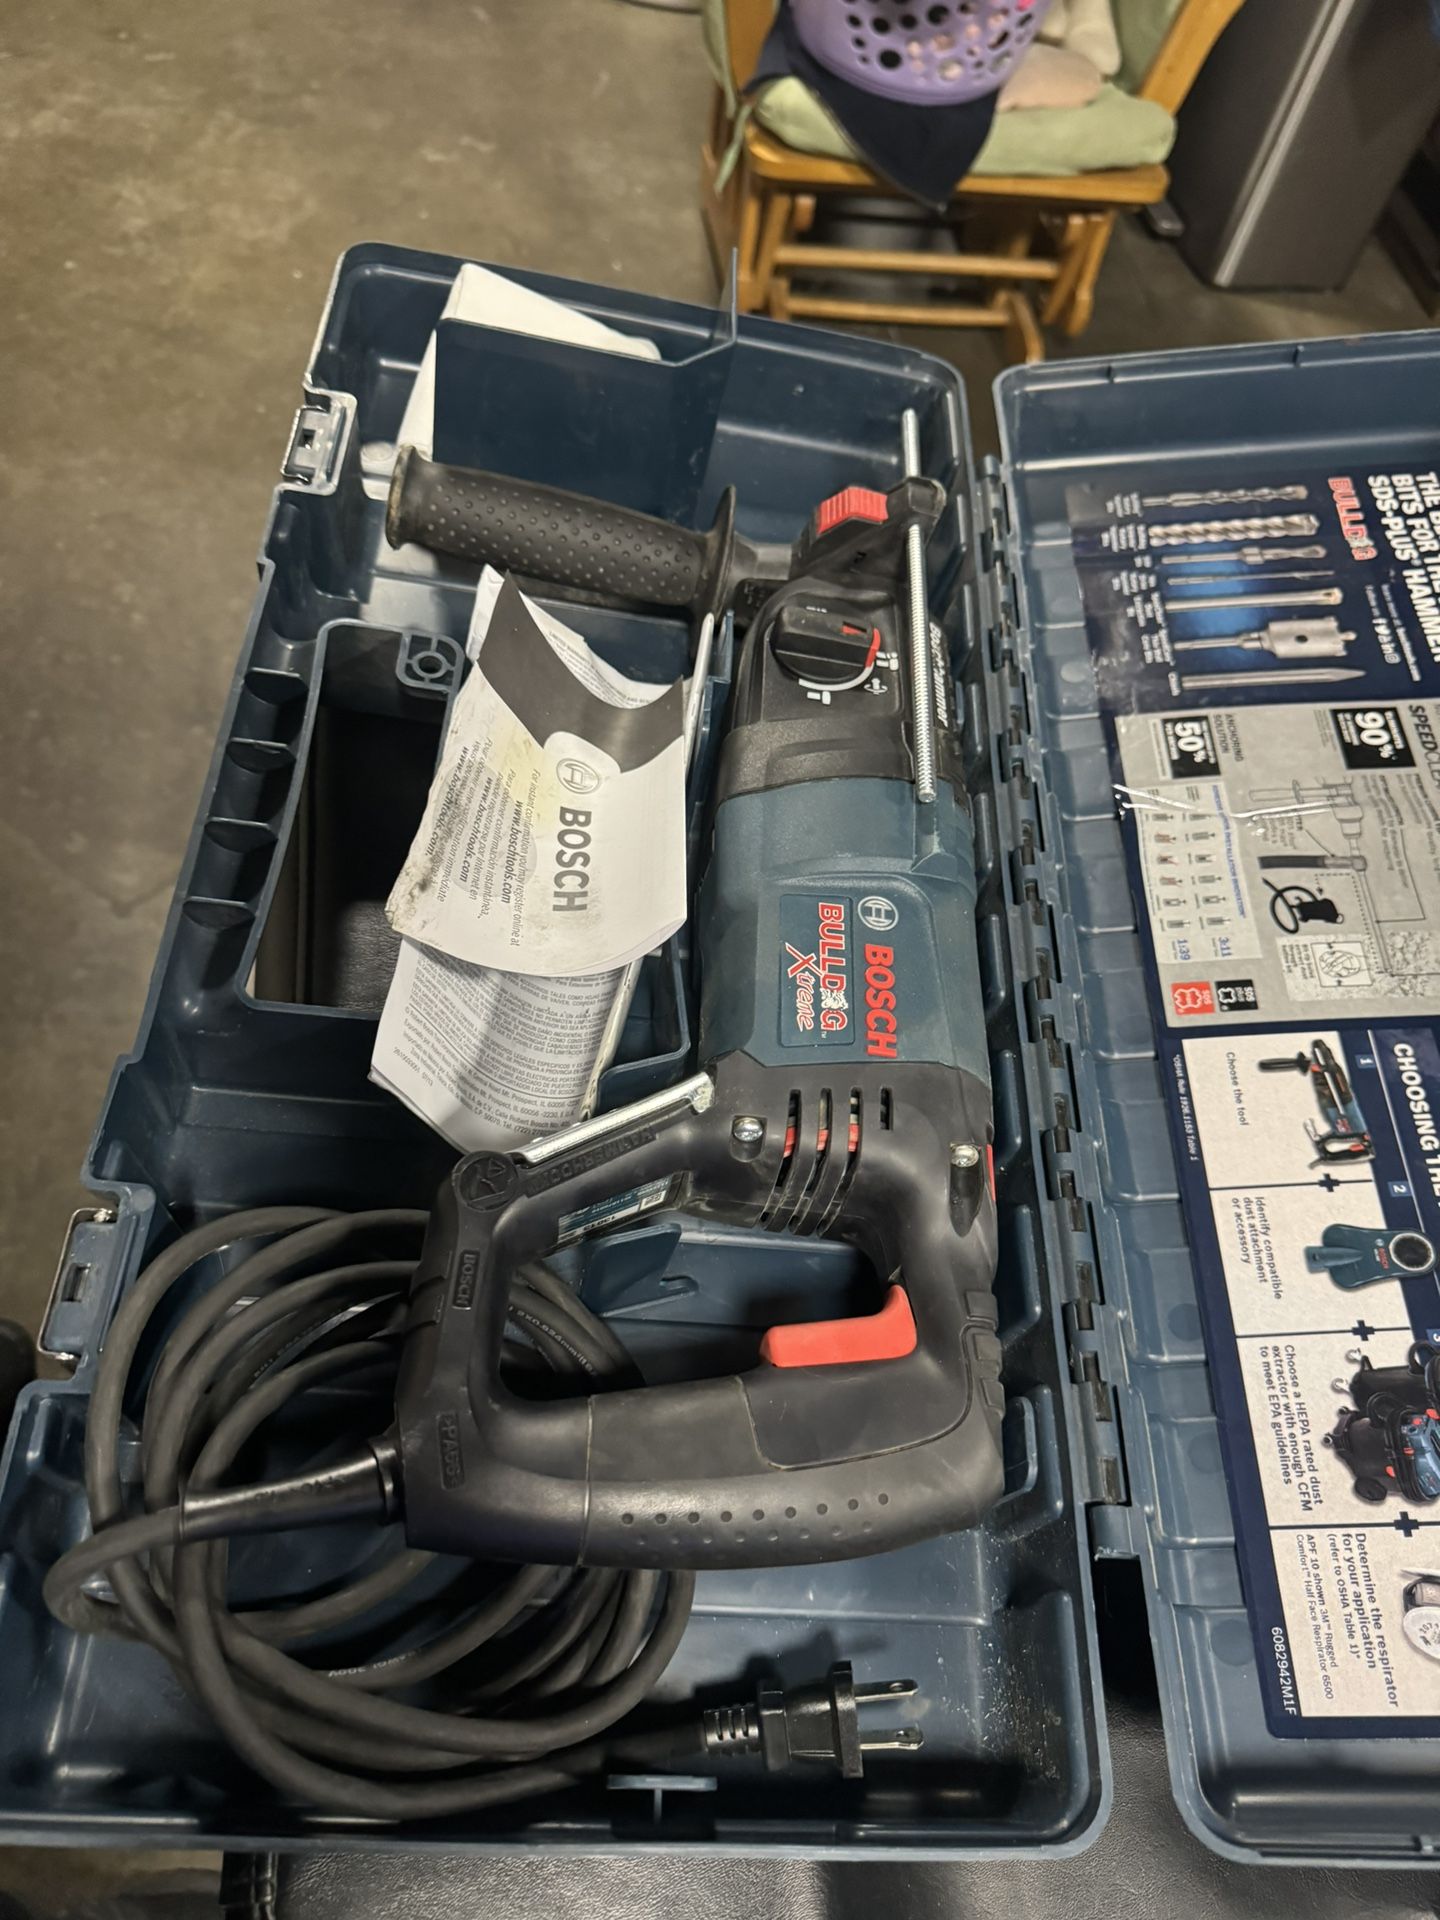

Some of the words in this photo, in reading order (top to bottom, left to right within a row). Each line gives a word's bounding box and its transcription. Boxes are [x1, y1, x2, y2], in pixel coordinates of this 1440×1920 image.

[1391, 474, 1424, 515] BITS
[1406, 517, 1439, 553] FOR
[481, 737, 494, 757] Pour
[1174, 722, 1206, 763] 50%
[1214, 714, 1230, 753] SOLUTION
[1225, 714, 1243, 762] ANCHORING
[472, 757, 486, 788] obtenir
[492, 772, 504, 799] puede
[505, 768, 517, 788] Para
[530, 768, 541, 783] For
[466, 786, 477, 803] une
[497, 787, 512, 820] obtener
[526, 783, 540, 809] instant
[460, 777, 494, 883] www.boschtools.com
[481, 798, 498, 842] registrarse
[520, 808, 534, 855] confirmation
[477, 841, 488, 858] por
[487, 819, 505, 870] confirmación
[501, 800, 524, 904] www.boschtools.com
[552, 806, 592, 912] BOSCH
[437, 856, 456, 902] immédiate
[470, 857, 485, 889] Internet
[468, 889, 478, 900] en
[513, 885, 526, 912] register
[510, 914, 523, 938] online
[510, 938, 520, 946] at
[1177, 939, 1191, 960] 1:39
[1219, 937, 1233, 957] 3:11
[784, 942, 823, 1032] Xtreme
[864, 943, 897, 1059] BOSCH
[1226, 1052, 1239, 1086] Choose
[1359, 1057, 1372, 1066] 1
[1233, 1089, 1244, 1104] the
[1394, 1043, 1438, 1151] CHOOSING
[1237, 1107, 1249, 1126] tool
[1231, 1198, 1240, 1208] or
[1393, 1184, 1406, 1194] 2
[1243, 1197, 1254, 1220] dust
[1234, 1212, 1251, 1264] accessory
[1248, 1223, 1268, 1283] attachment
[1255, 1196, 1271, 1236] Identify
[1264, 1239, 1283, 1300] compatible
[456, 1252, 478, 1307] BOSCH
[1259, 1346, 1269, 1358] to
[1284, 1345, 1300, 1387] Choose
[1262, 1361, 1276, 1391] meet
[1272, 1346, 1290, 1399] extractor
[1268, 1394, 1281, 1419] EPA
[1282, 1402, 1296, 1429] with
[1295, 1402, 1311, 1436] HEPA
[1271, 1422, 1292, 1485] guidelines
[1288, 1432, 1304, 1478] enough
[1302, 1439, 1318, 1472] rated
[1297, 1482, 1313, 1512] CFM
[1310, 1476, 1324, 1505] dust
[1306, 1534, 1317, 1555] APF
[1327, 1533, 1341, 1563] (refer
[1341, 1533, 1355, 1554] for
[1309, 1557, 1320, 1570] 10
[1334, 1566, 1343, 1576] to
[1343, 1556, 1360, 1587] your
[1355, 1533, 1376, 1604] Determine
[1304, 1581, 1316, 1598] Half
[1312, 1572, 1326, 1606] shown
[1336, 1578, 1350, 1609] OSHA
[1308, 1600, 1319, 1621] Face
[1343, 1612, 1357, 1640] Table
[1370, 1608, 1383, 1630] the
[1352, 1591, 1377, 1669] application
[1312, 1624, 1328, 1672] Respirator
[1324, 1632, 1338, 1668] Rugged
[1271, 1626, 1297, 1716] 6082942M1F
[1374, 1635, 1399, 1707] respirator
[1322, 1674, 1334, 1700] 6500
